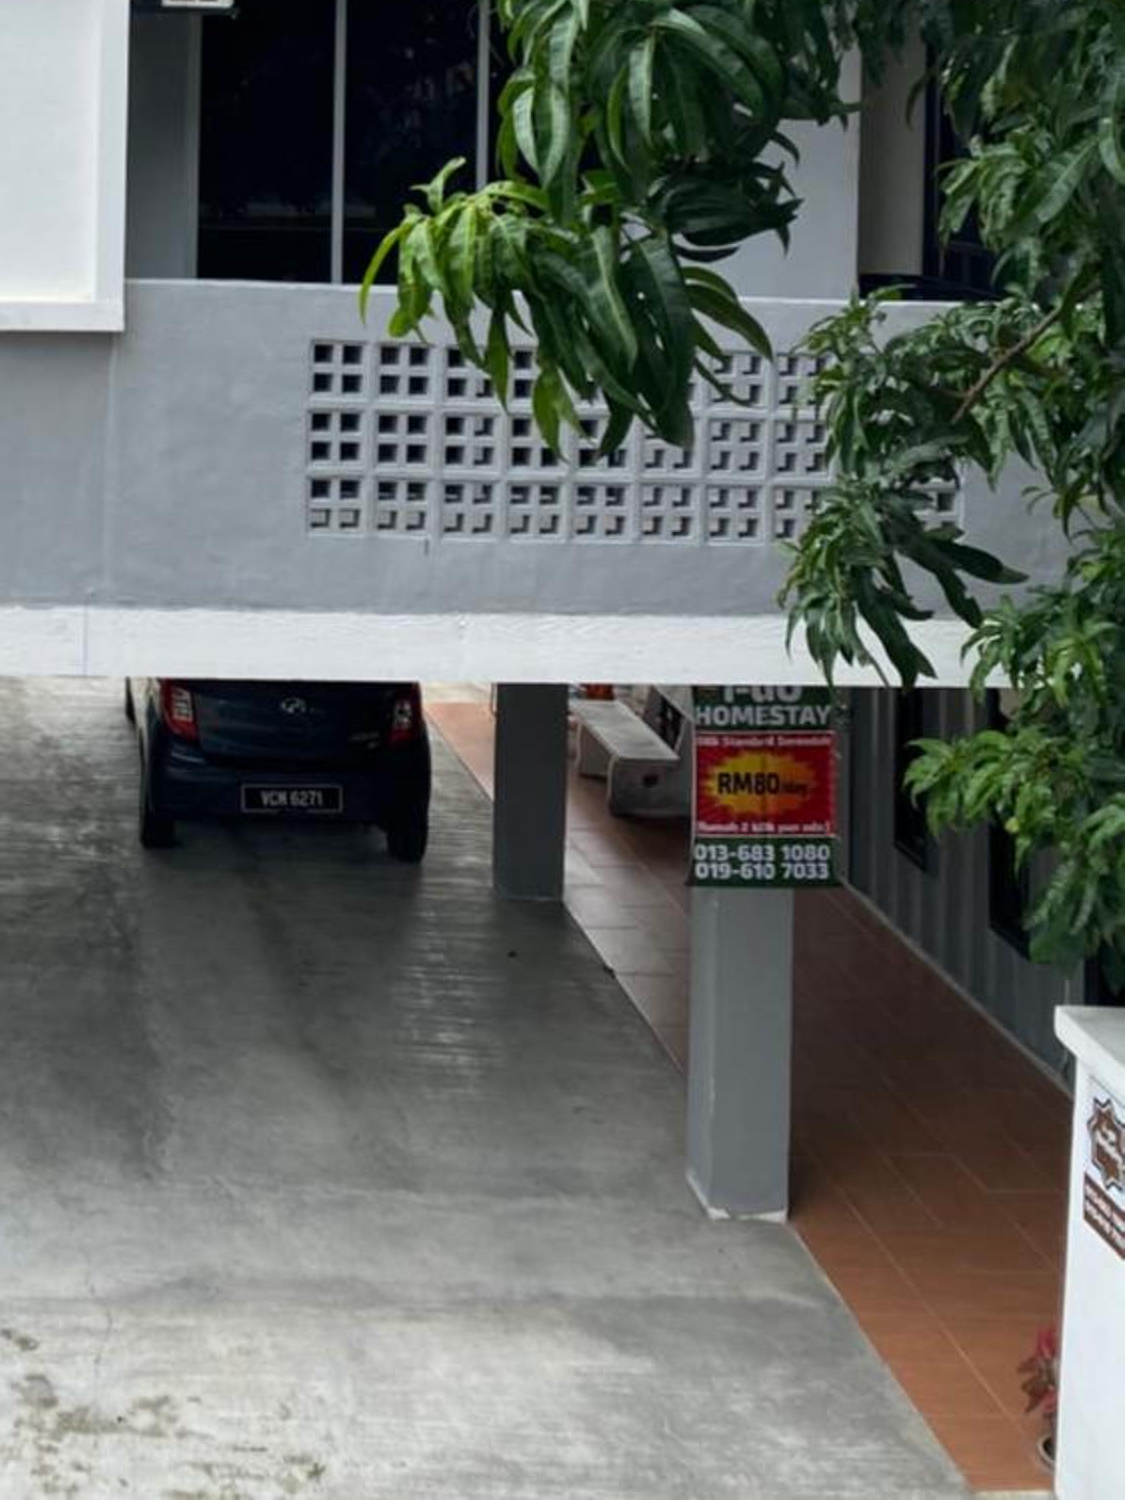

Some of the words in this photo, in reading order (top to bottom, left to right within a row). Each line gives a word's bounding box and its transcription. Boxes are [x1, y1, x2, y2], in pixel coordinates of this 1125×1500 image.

[695, 705, 831, 725] HOMESTAY
[717, 772, 780, 795] RM80
[290, 790, 322, 807] 6271
[693, 844, 774, 862] 013-683
[781, 844, 831, 862] 1080
[694, 862, 775, 879] 019-610
[781, 862, 830, 879] 7033
